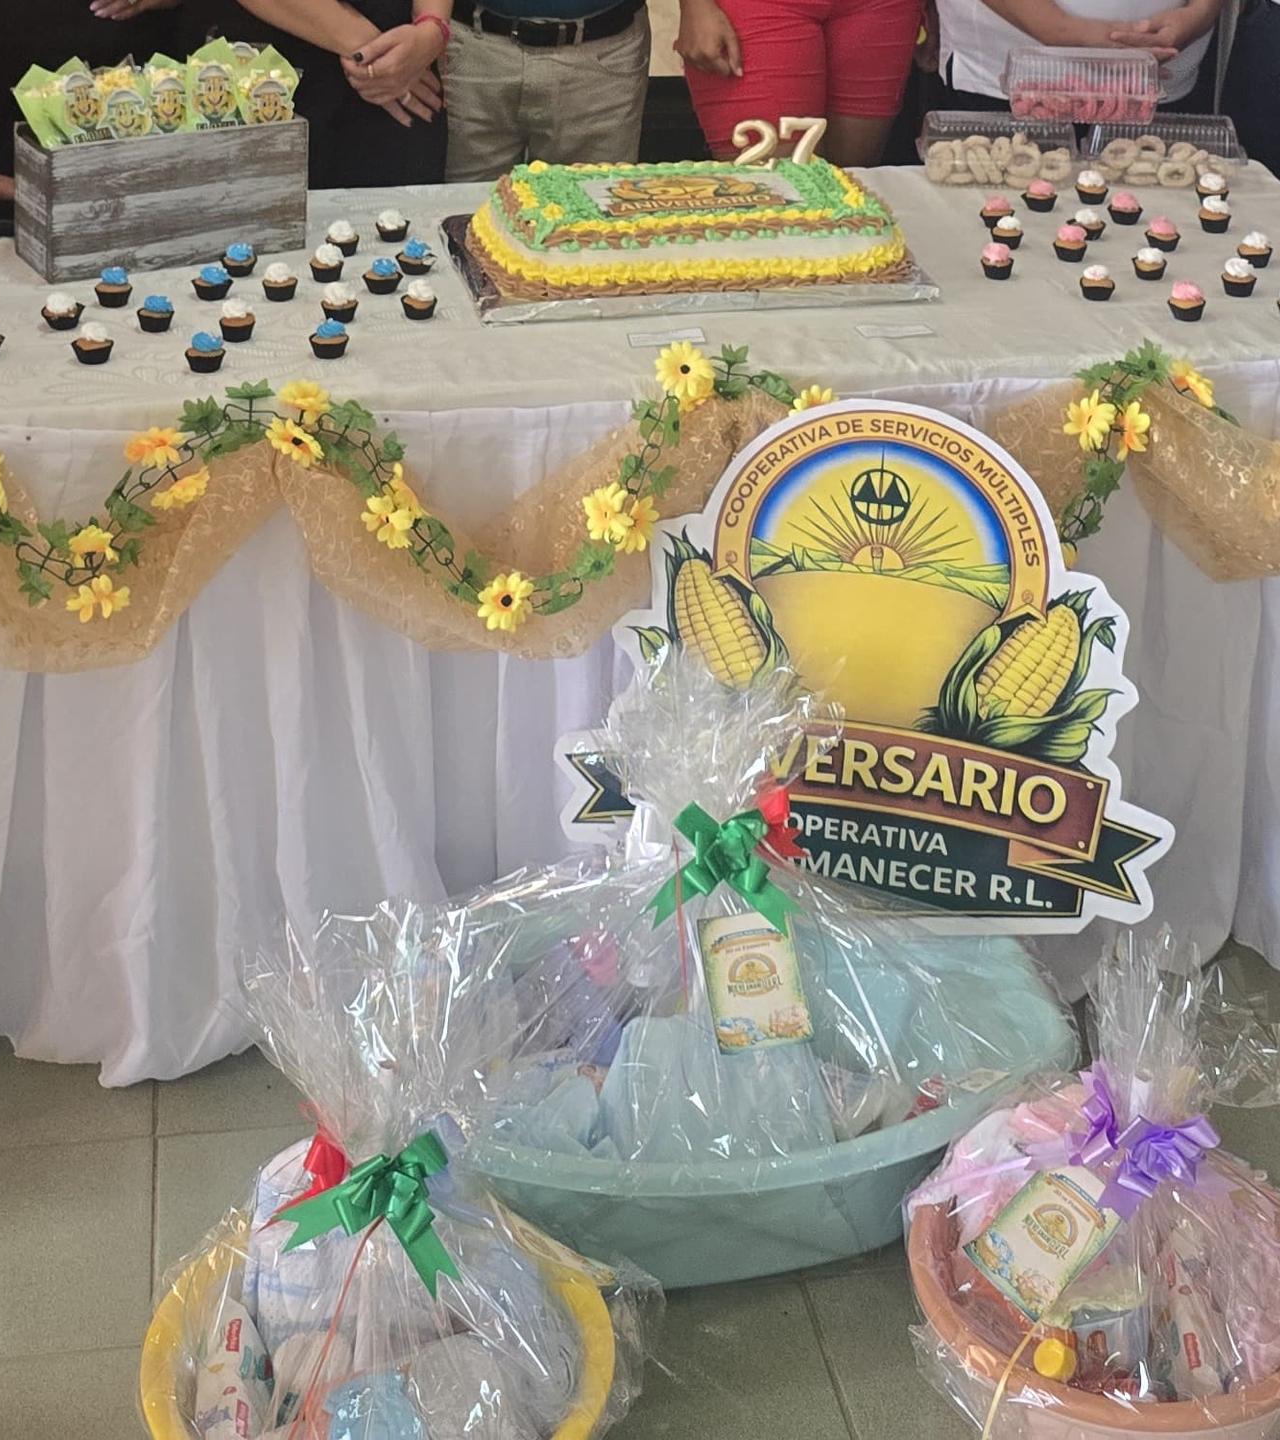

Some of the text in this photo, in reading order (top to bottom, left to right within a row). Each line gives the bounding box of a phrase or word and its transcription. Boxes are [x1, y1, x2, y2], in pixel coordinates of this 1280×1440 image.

[732, 116, 828, 171] 27
[620, 194, 771, 212] ANIVERSARIO
[725, 418, 1041, 568] COOPERATIVA DE SERVICIOS MÚLTIPLES
[989, 873, 1054, 910] R.L.
